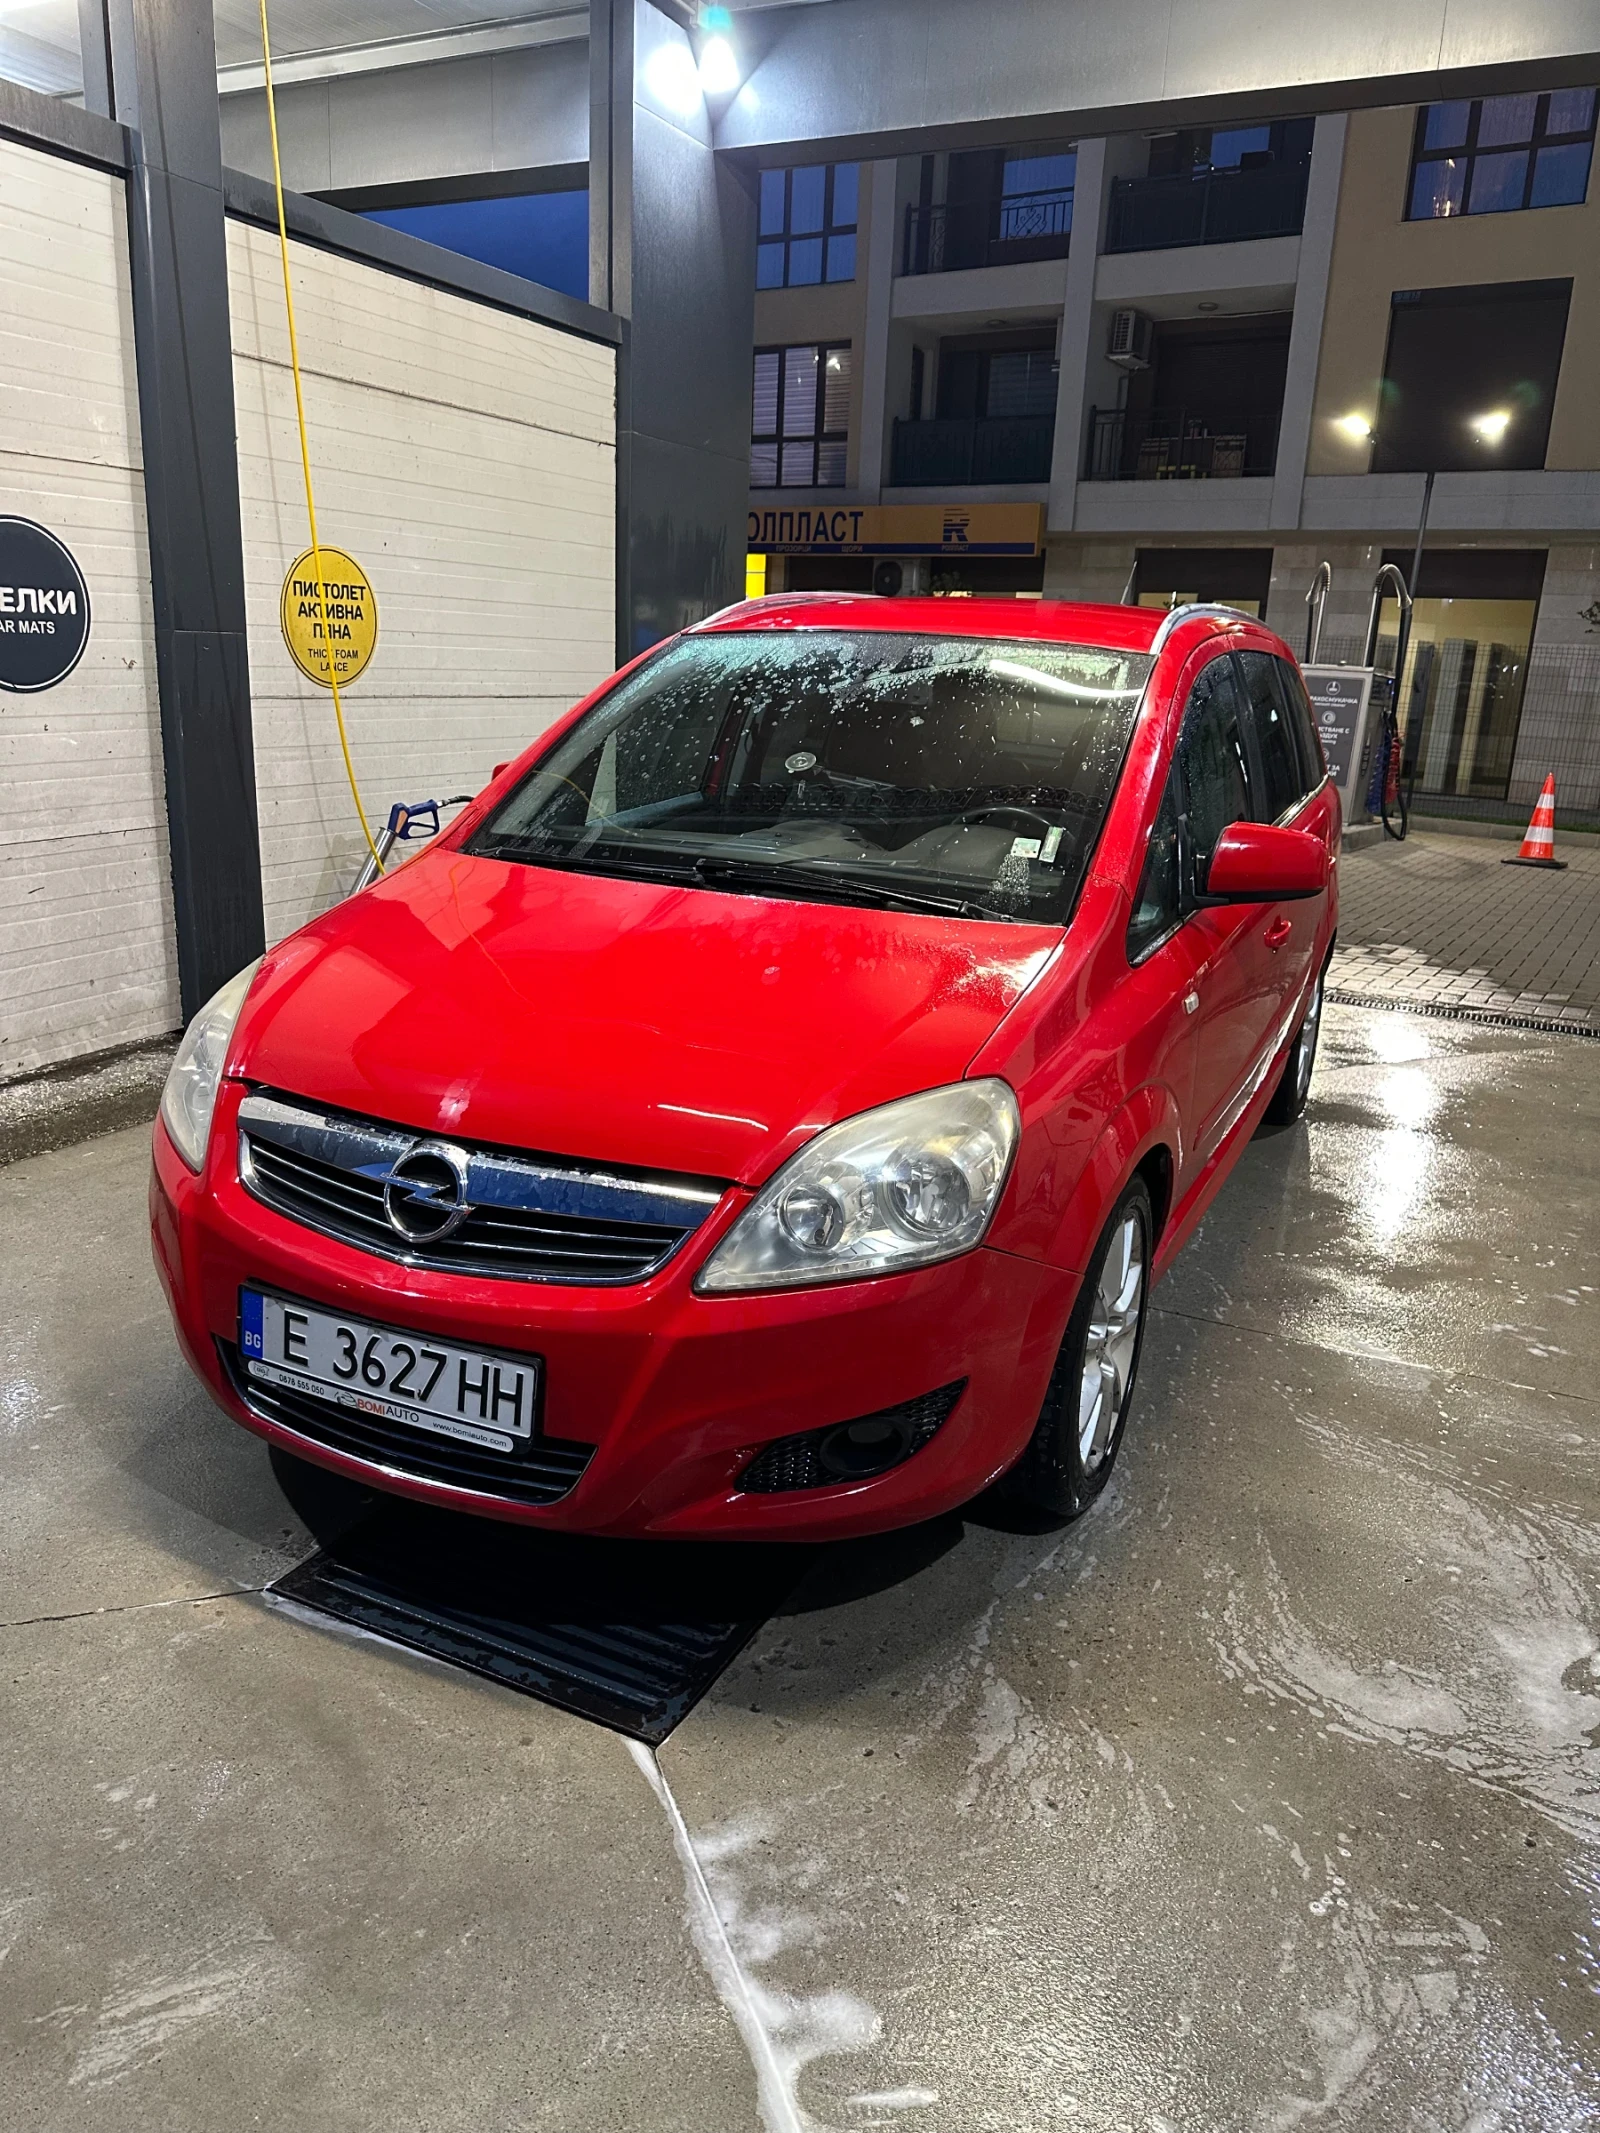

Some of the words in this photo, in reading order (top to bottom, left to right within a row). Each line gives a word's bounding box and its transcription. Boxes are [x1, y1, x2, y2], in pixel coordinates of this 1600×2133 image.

[0, 586, 77, 615] ЕЛКИ
[18, 620, 56, 635] MATS
[308, 648, 333, 659] THIC
[335, 649, 359, 659] FOAM
[245, 1331, 261, 1348] BG
[284, 1309, 309, 1367] E
[333, 1327, 447, 1402] 3627
[457, 1358, 524, 1427] HH
[278, 1374, 296, 1386] 0878
[297, 1379, 310, 1391] 555
[311, 1384, 325, 1395] 050
[432, 1421, 507, 1448] www.bomiauto.com
